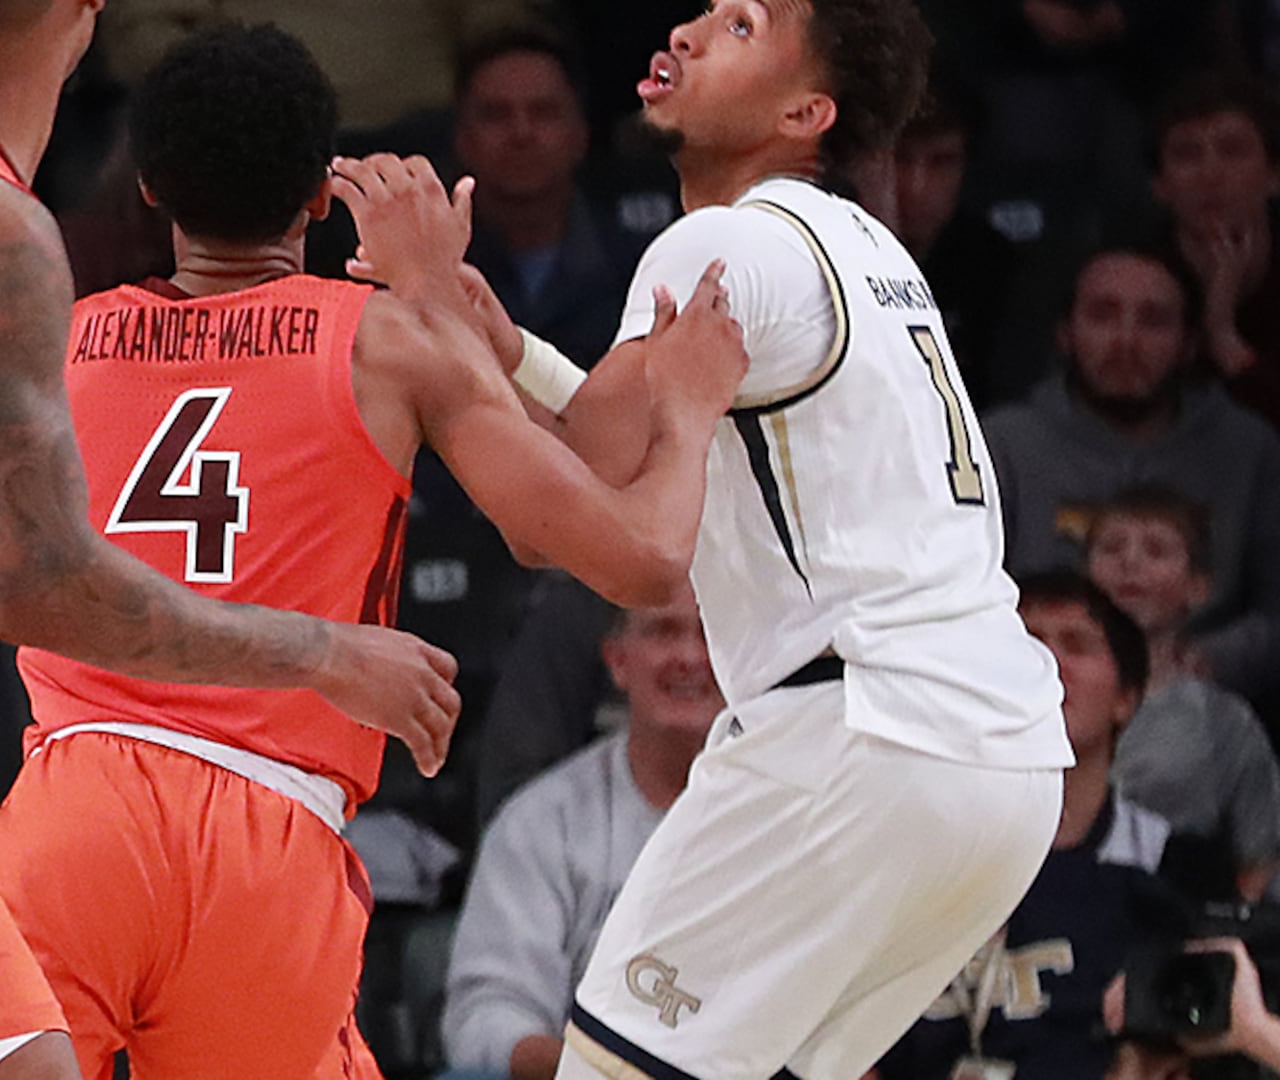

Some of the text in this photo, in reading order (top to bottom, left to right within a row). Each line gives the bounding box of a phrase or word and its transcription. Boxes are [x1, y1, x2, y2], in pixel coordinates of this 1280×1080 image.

[865, 275, 927, 311] BANKS
[71, 306, 319, 364] ALEXANDER-WALKER
[906, 325, 986, 506] 1
[104, 386, 251, 584] 4
[625, 953, 703, 1030] GT
